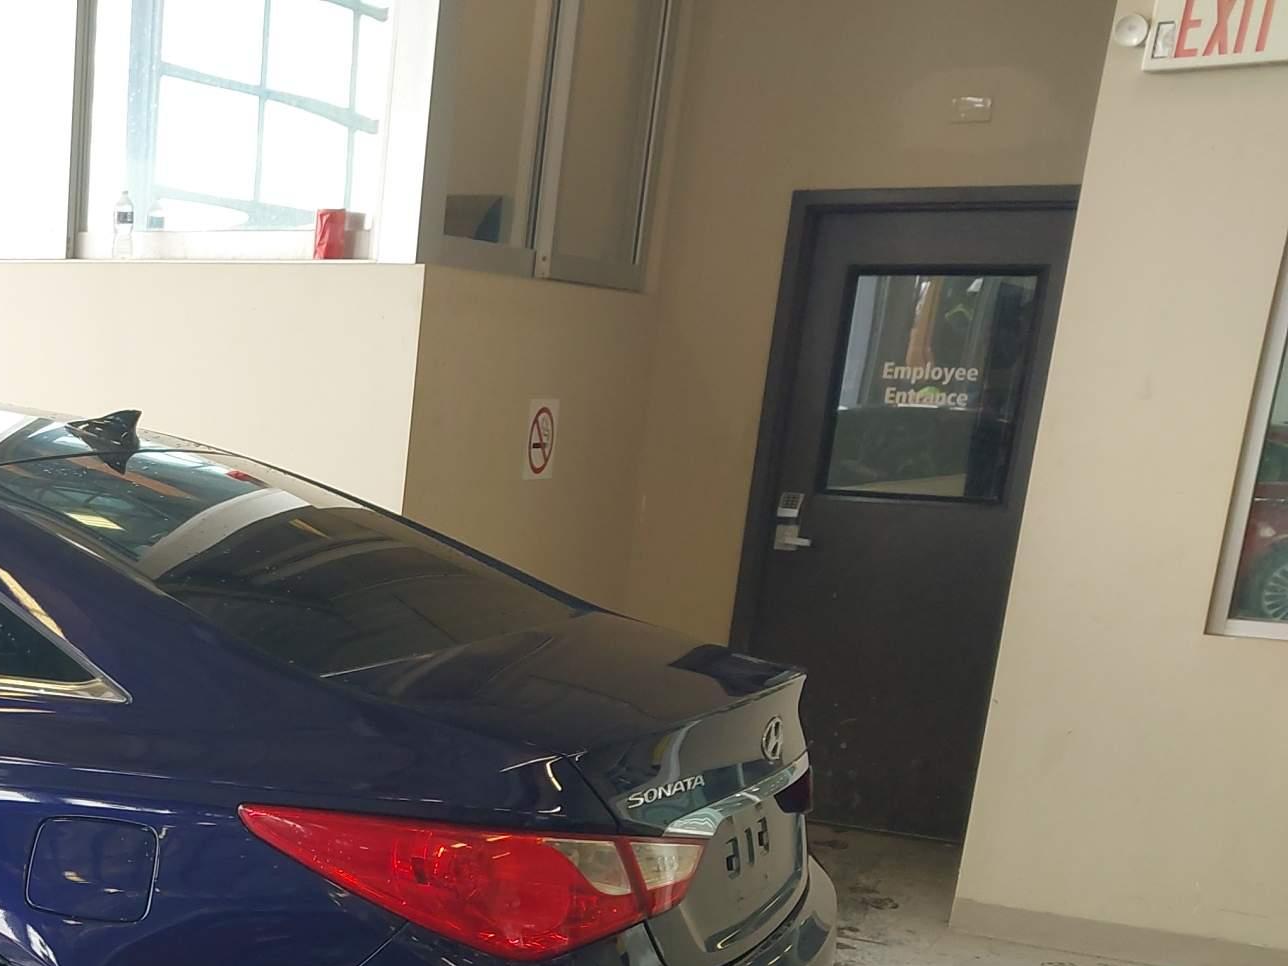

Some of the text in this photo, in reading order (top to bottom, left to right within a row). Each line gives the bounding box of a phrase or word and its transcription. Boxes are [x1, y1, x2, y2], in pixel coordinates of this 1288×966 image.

[882, 362, 979, 385] Employee
[884, 386, 969, 407] Entrance
[627, 775, 706, 809] SONATA
